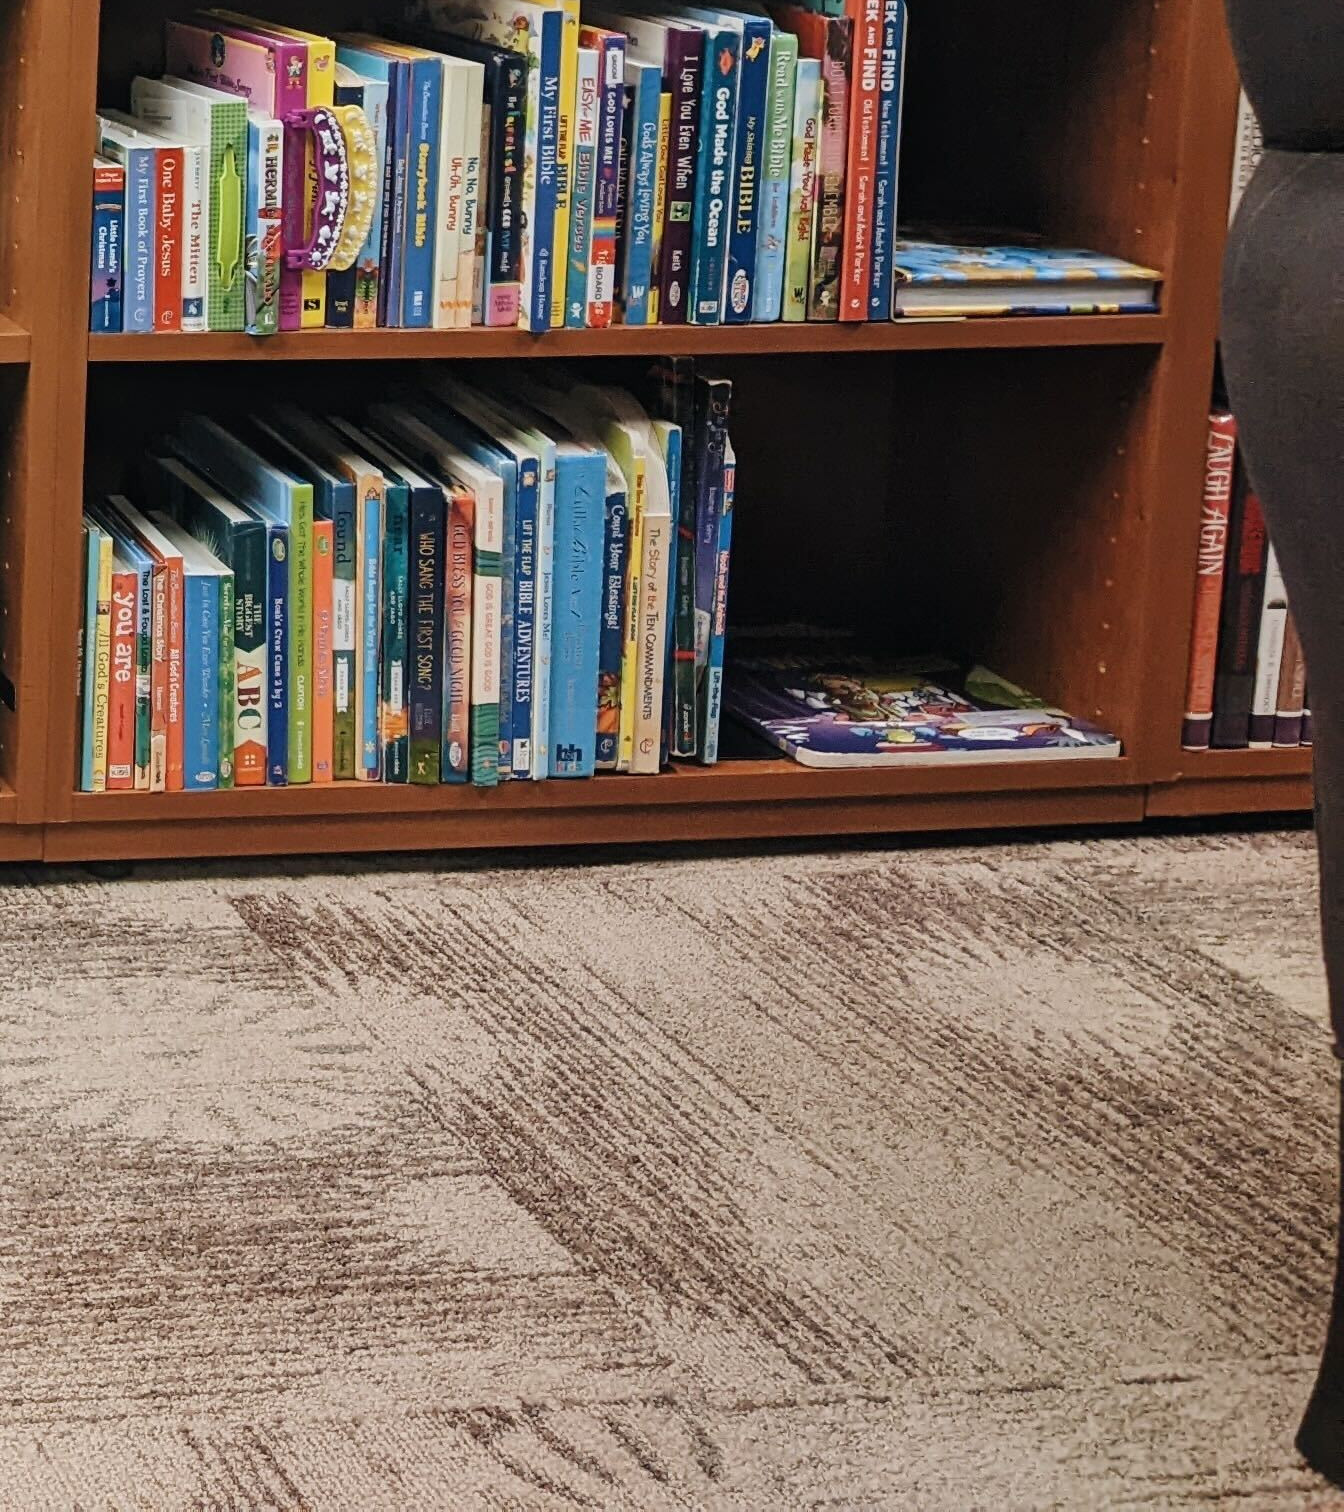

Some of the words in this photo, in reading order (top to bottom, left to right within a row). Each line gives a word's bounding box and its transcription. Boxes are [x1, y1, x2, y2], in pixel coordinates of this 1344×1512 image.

[867, 26, 876, 45] AND
[885, 27, 896, 46] AND
[544, 76, 558, 97] My
[862, 48, 878, 91] FIND
[880, 49, 896, 92] FIND
[542, 103, 557, 137] First
[715, 87, 731, 119] God
[540, 141, 556, 185] Bible
[713, 124, 729, 165] Made
[710, 169, 725, 195] the
[707, 200, 723, 247] Ocean
[1204, 431, 1236, 502] LAUGH
[1198, 507, 1228, 576] AGAIN
[113, 591, 134, 637] you
[114, 644, 133, 683] are
[237, 661, 262, 730] ABC
